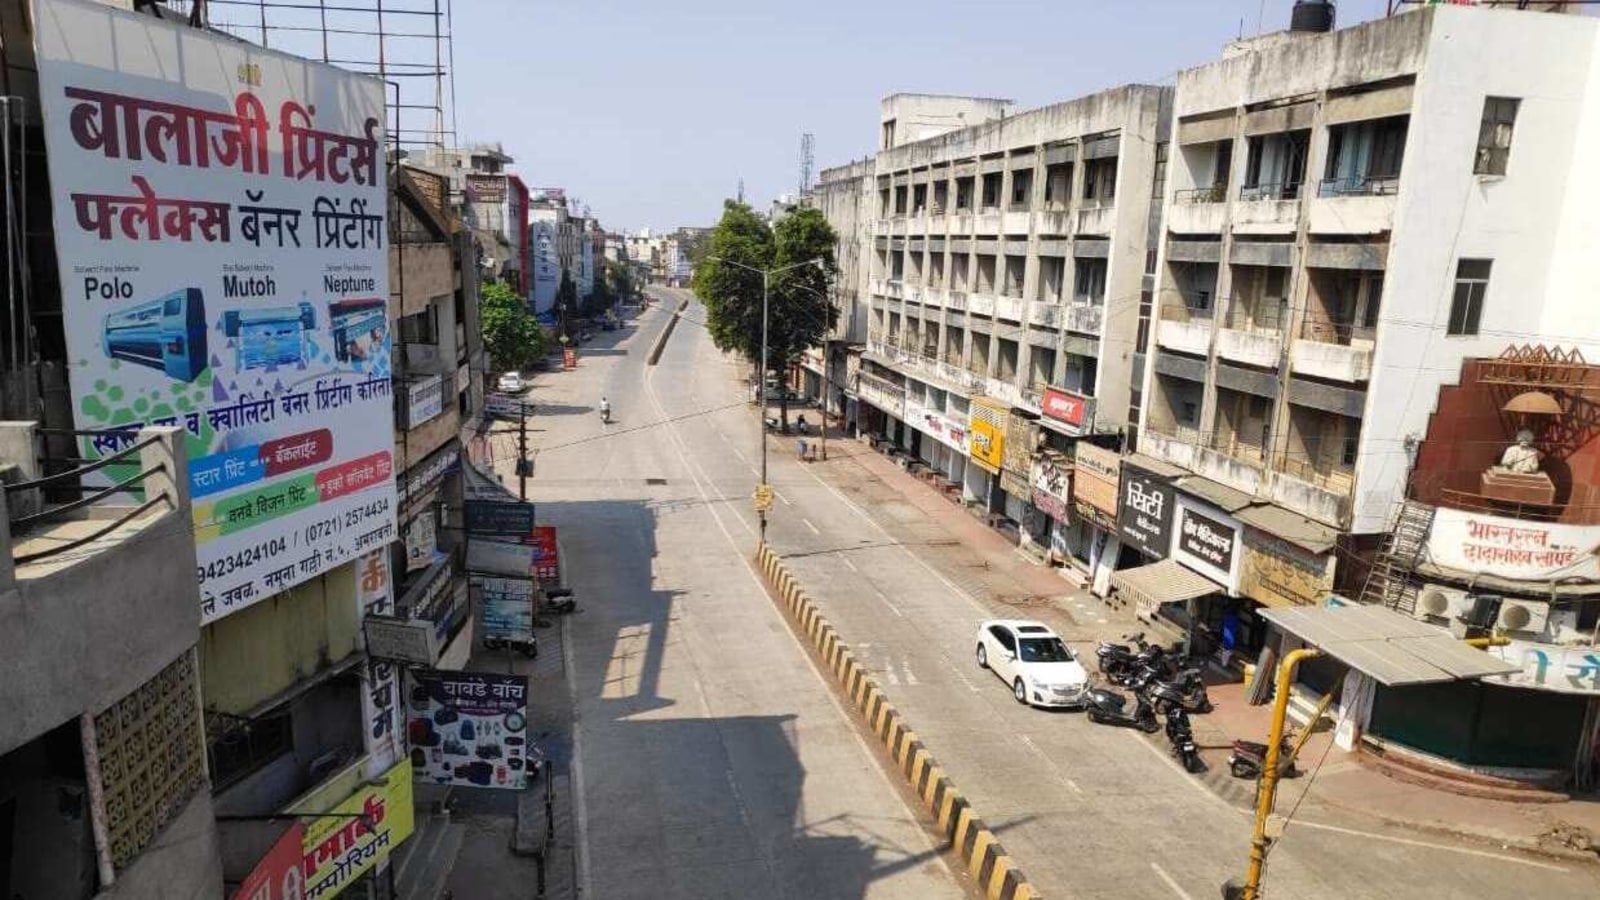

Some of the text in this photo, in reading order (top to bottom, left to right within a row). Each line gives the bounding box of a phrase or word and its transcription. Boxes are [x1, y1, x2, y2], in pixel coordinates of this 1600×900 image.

[64, 86, 379, 187] बालाजी प्रिंटर्स
[70, 175, 231, 242] फ्लेक्स
[238, 190, 301, 248] बॅनर
[84, 276, 134, 300] Polo
[222, 275, 276, 298] Mutoh
[324, 275, 375, 296] Neptune
[184, 413, 199, 436] व
[281, 389, 310, 416] बॅनर
[356, 372, 391, 401] करिता
[192, 457, 246, 489] स्टार प्रिंट
[1125, 481, 1164, 520] सिटी
[304, 516, 342, 546] (0721)
[345, 498, 389, 528] 2574434
[492, 680, 525, 698] वॉच
